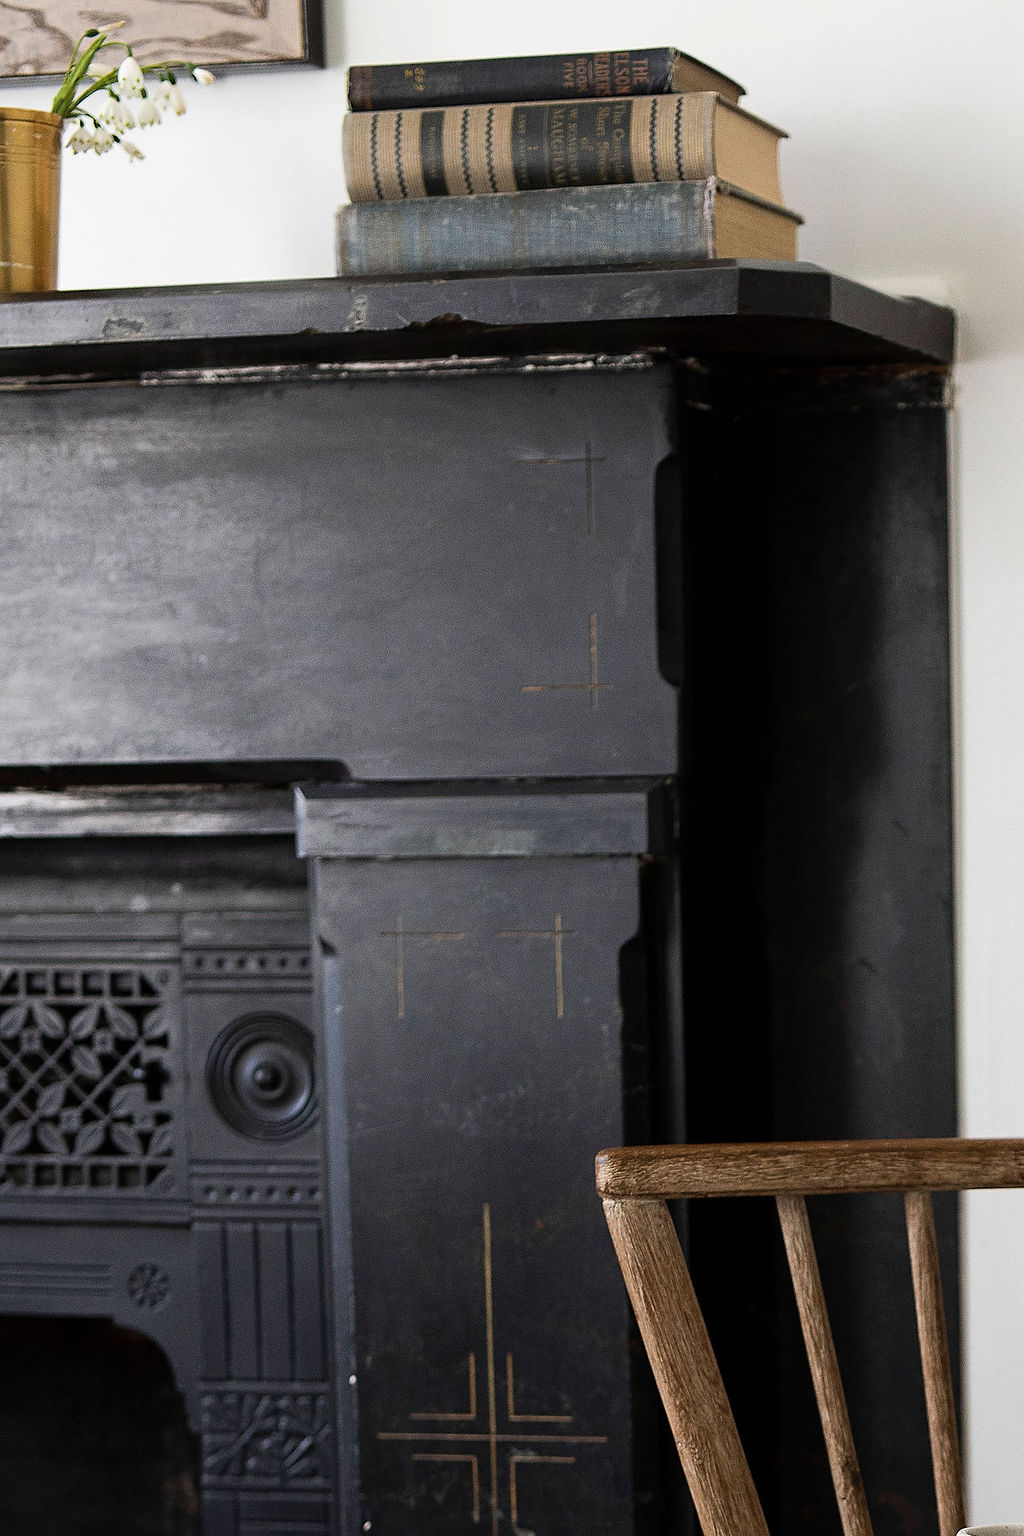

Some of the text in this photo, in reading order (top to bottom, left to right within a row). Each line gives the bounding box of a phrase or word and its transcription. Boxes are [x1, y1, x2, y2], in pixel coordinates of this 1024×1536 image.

[563, 61, 575, 88] FIVE
[575, 58, 588, 92] BOOK
[594, 52, 612, 97] READERS
[614, 52, 631, 95] ELSON
[631, 58, 649, 85] THE
